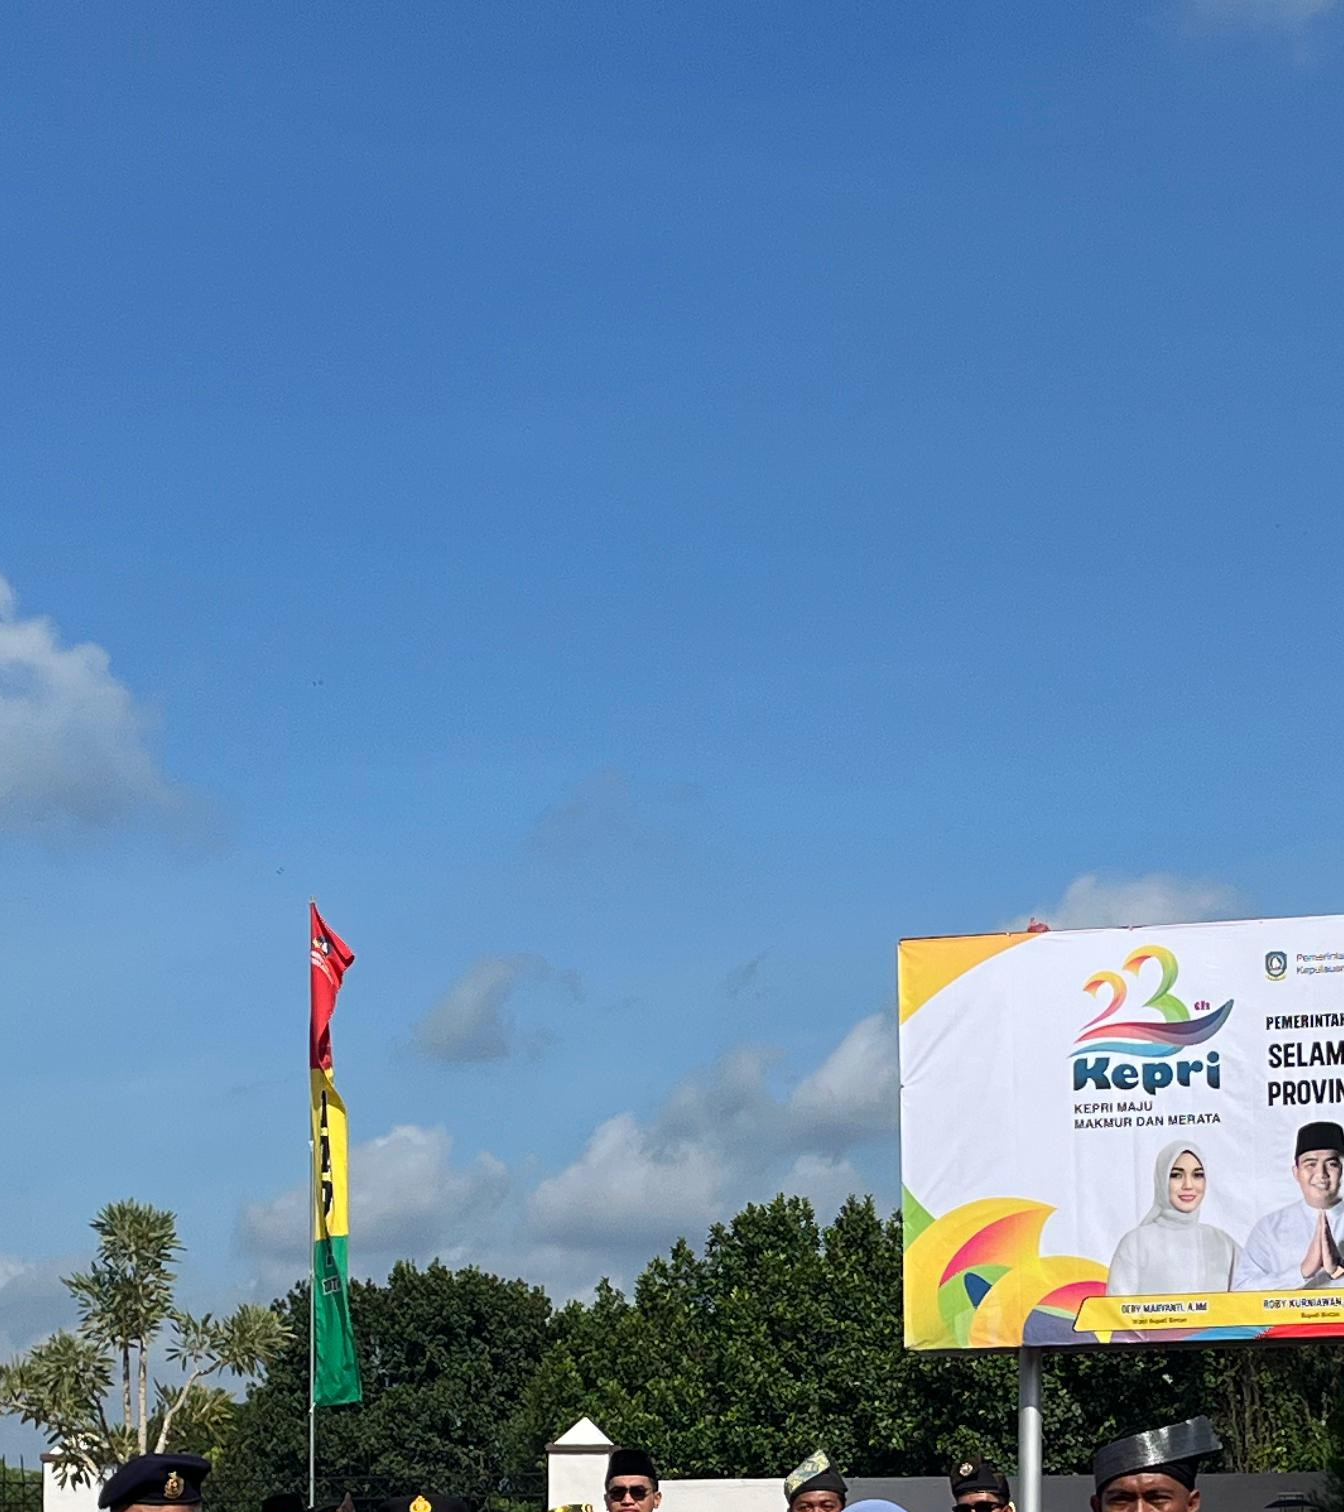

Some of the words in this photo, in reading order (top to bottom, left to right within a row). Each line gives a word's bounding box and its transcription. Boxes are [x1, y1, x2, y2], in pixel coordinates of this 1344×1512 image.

[1073, 1051, 1221, 1096] Kepri
[1074, 1102, 1113, 1115] KEPRI
[1117, 1101, 1153, 1113] MAJU
[1074, 1117, 1133, 1129] MAKMUR
[1136, 1116, 1164, 1127] DAN
[1168, 1113, 1221, 1126] MERATA
